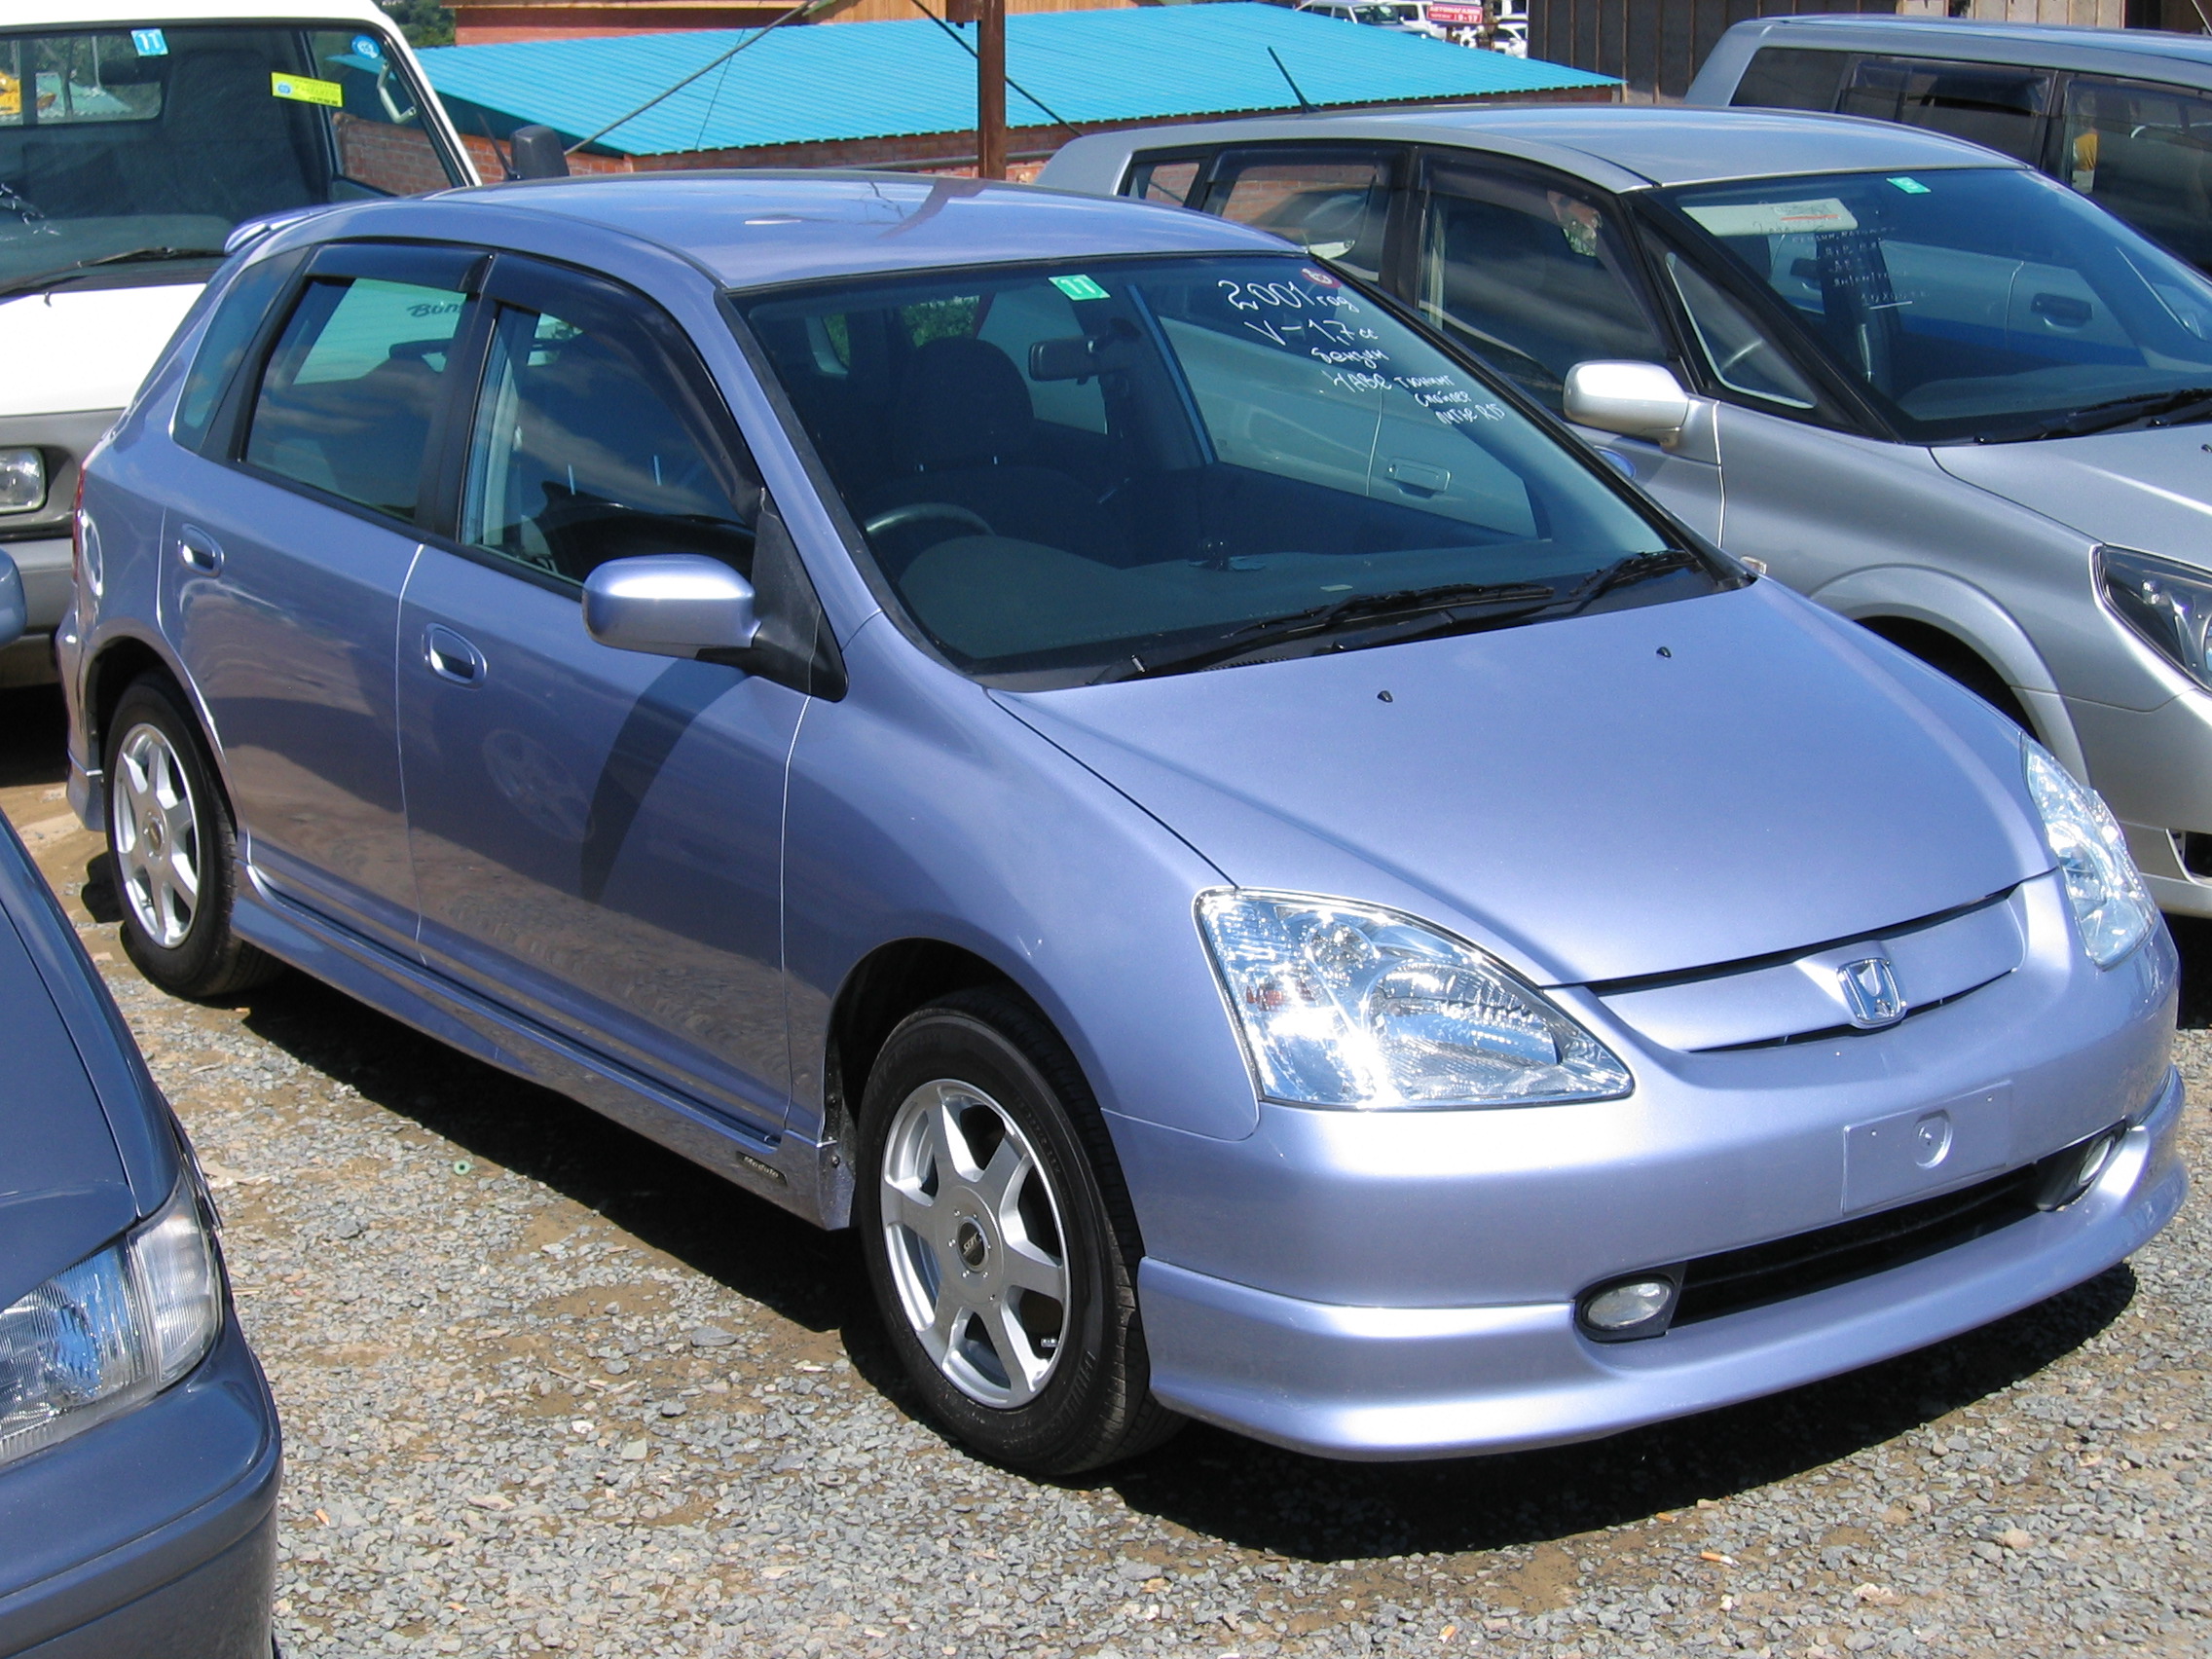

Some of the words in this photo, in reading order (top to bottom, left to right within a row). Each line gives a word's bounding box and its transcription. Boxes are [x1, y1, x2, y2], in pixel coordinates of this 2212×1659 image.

[138, 33, 161, 51] 11
[1059, 276, 1097, 295] 11
[1217, 278, 1315, 312] 2001
